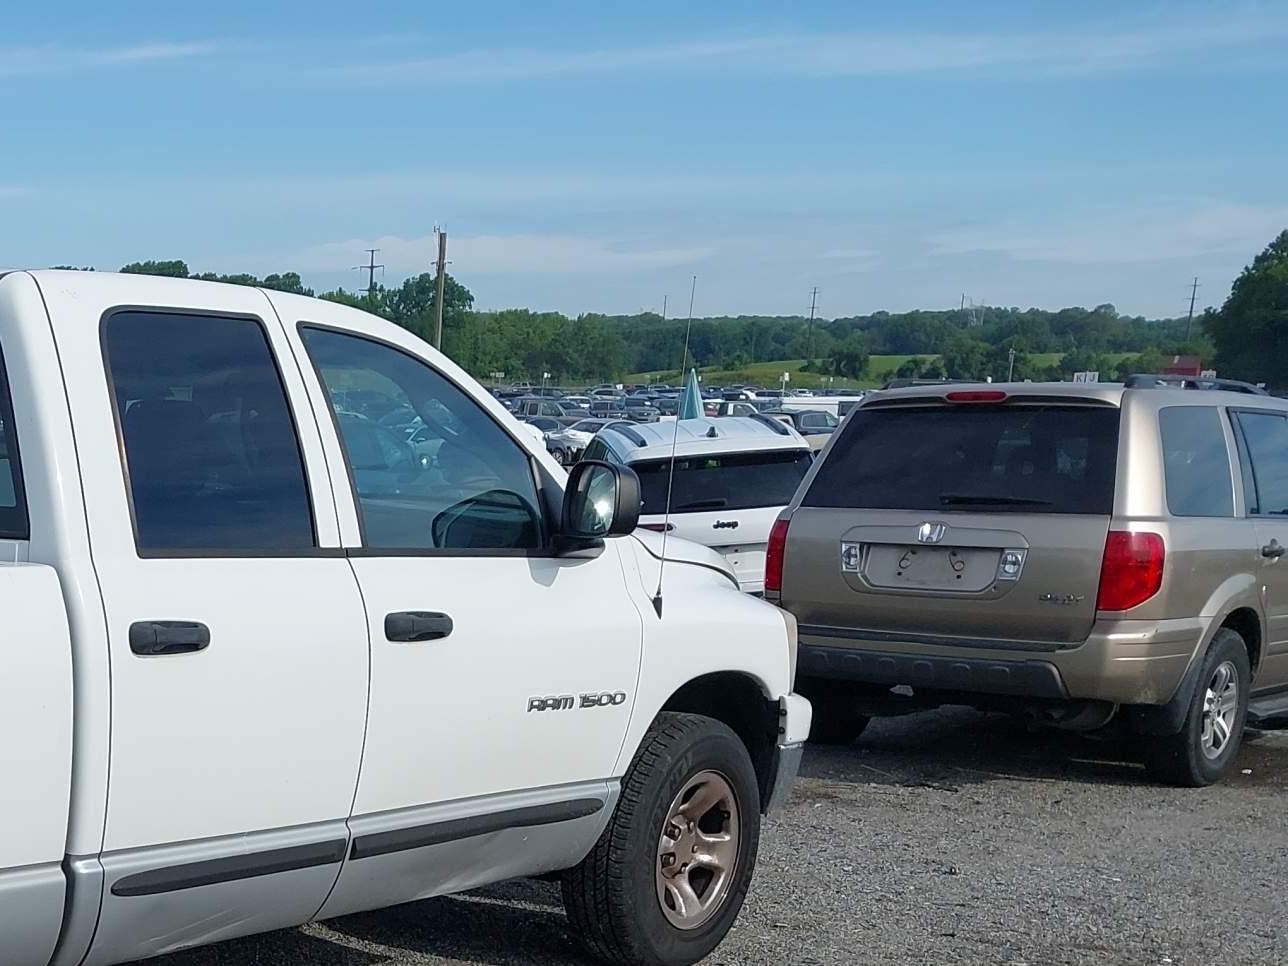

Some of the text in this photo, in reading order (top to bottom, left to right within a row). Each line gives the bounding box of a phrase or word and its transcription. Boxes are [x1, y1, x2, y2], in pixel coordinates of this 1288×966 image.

[712, 519, 739, 530] Jeep
[527, 692, 626, 712] RAM 1500
